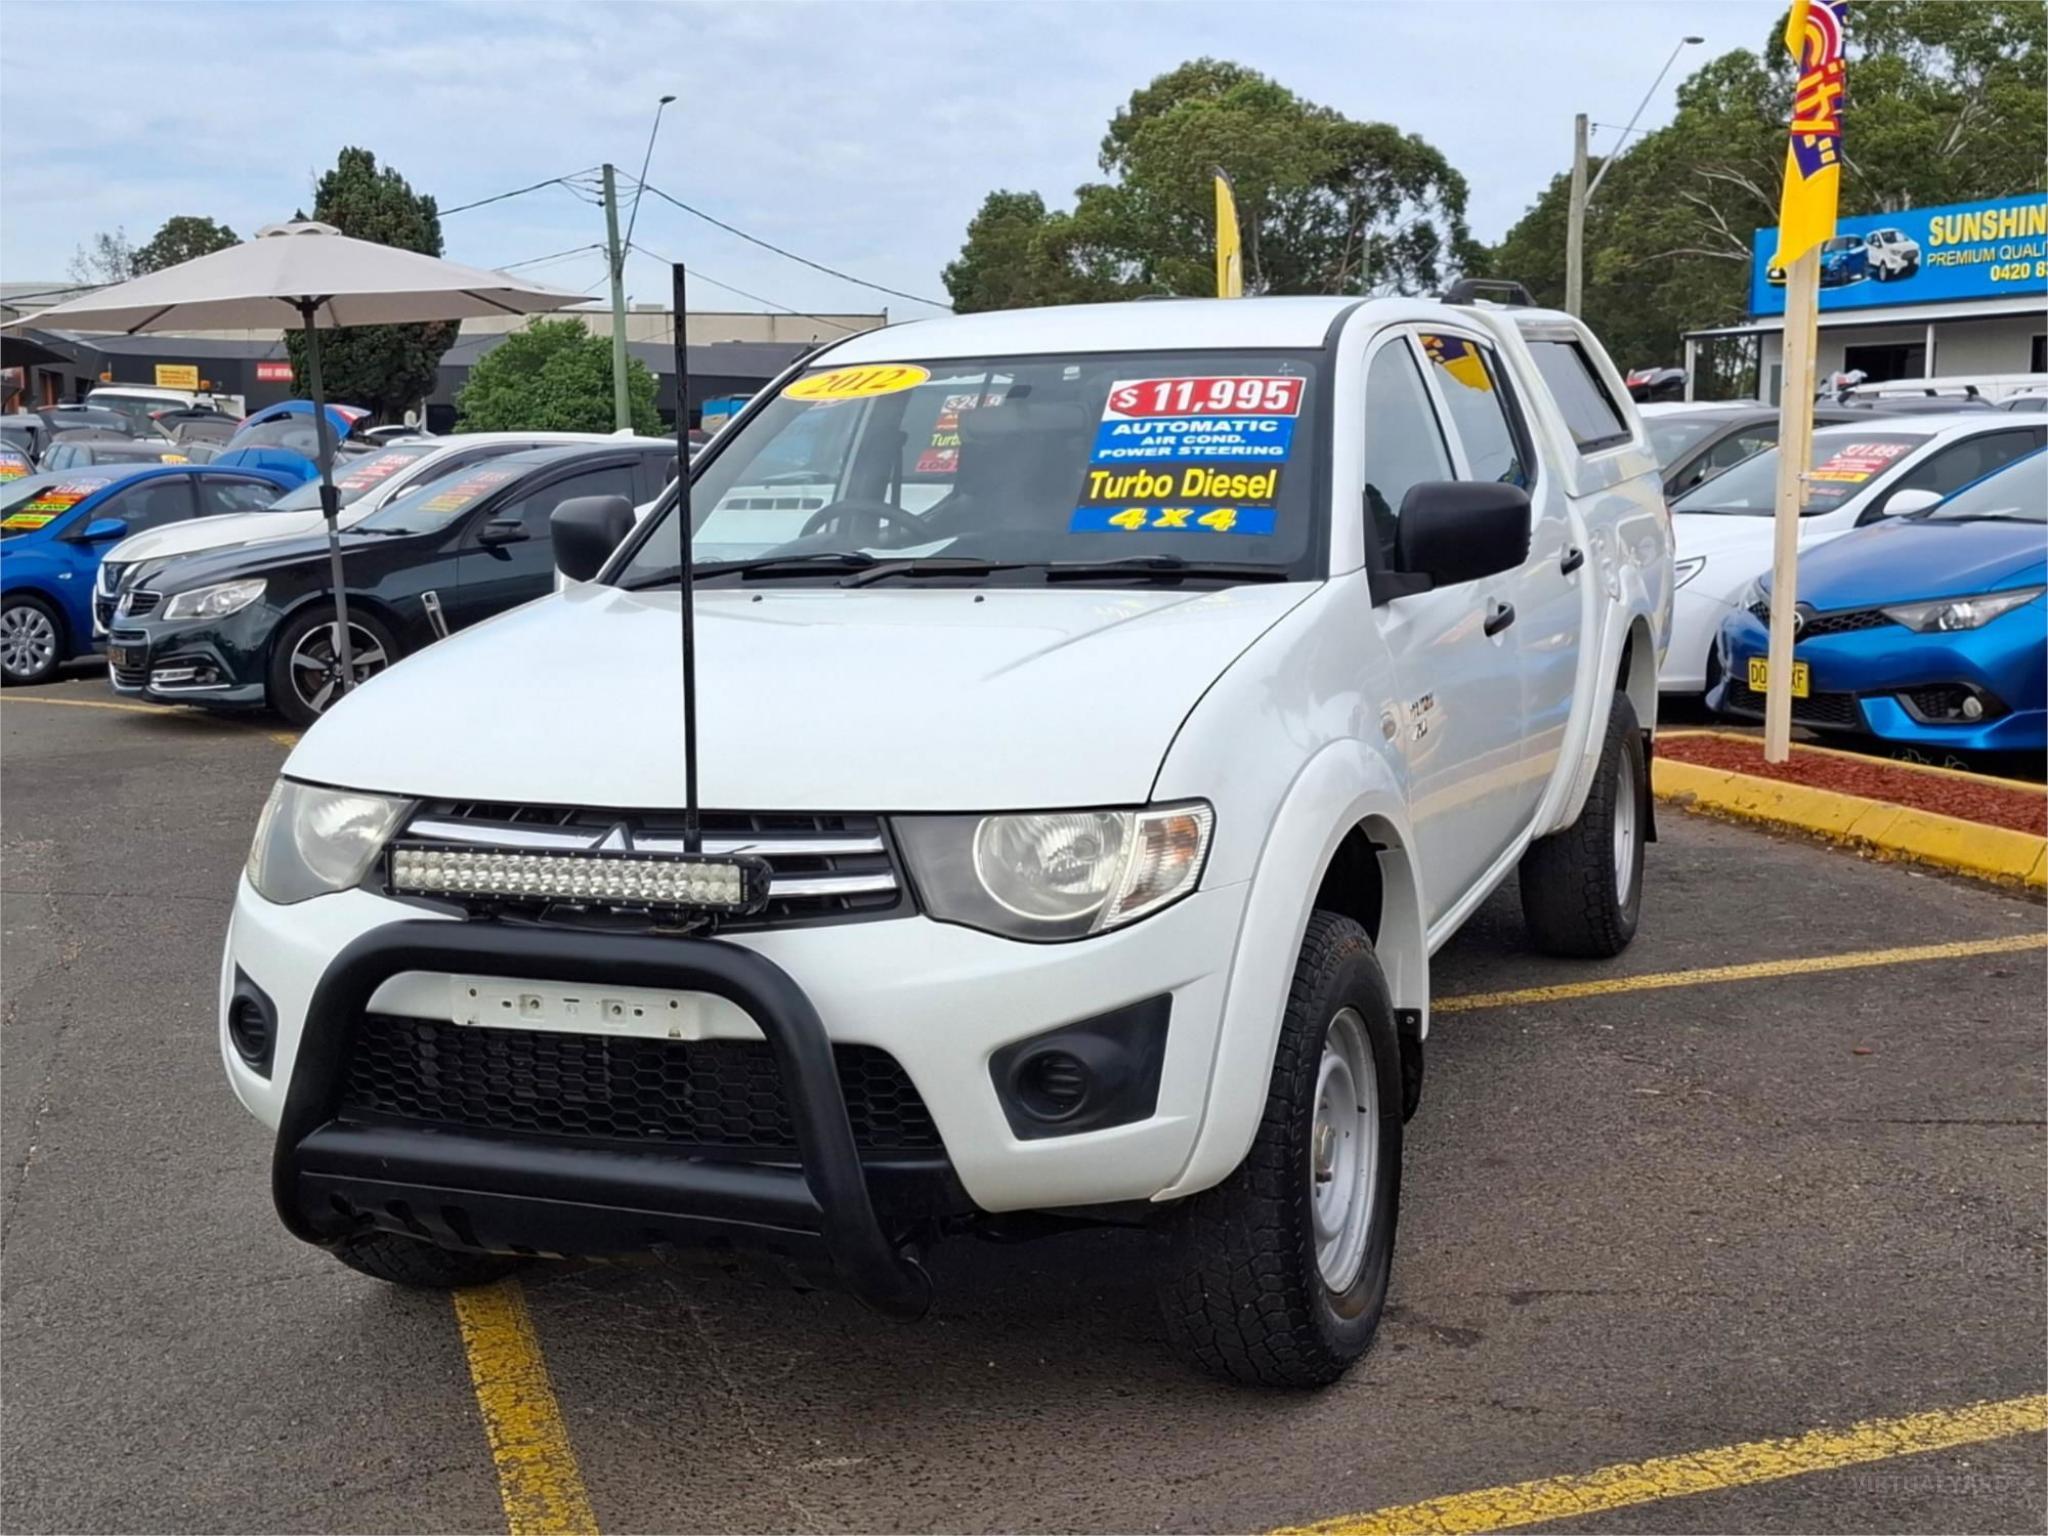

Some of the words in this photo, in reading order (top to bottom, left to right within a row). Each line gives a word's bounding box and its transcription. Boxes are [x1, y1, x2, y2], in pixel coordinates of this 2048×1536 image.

[1927, 247, 1996, 267] PREMIUM
[1990, 262, 2031, 281] 0420
[2036, 260, 2048, 278] 8
[802, 368, 908, 396] 2012
[1154, 379, 1292, 412] 11,995
[1112, 420, 1279, 436] AUTOMATIC
[931, 432, 961, 447] Turb
[1141, 435, 1177, 445] AIR
[1183, 434, 1247, 444] COND.
[1098, 446, 1172, 458] POWER
[1178, 445, 1284, 456] STEERING
[1089, 469, 1174, 499] Turbo
[1181, 467, 1278, 499] Diesel
